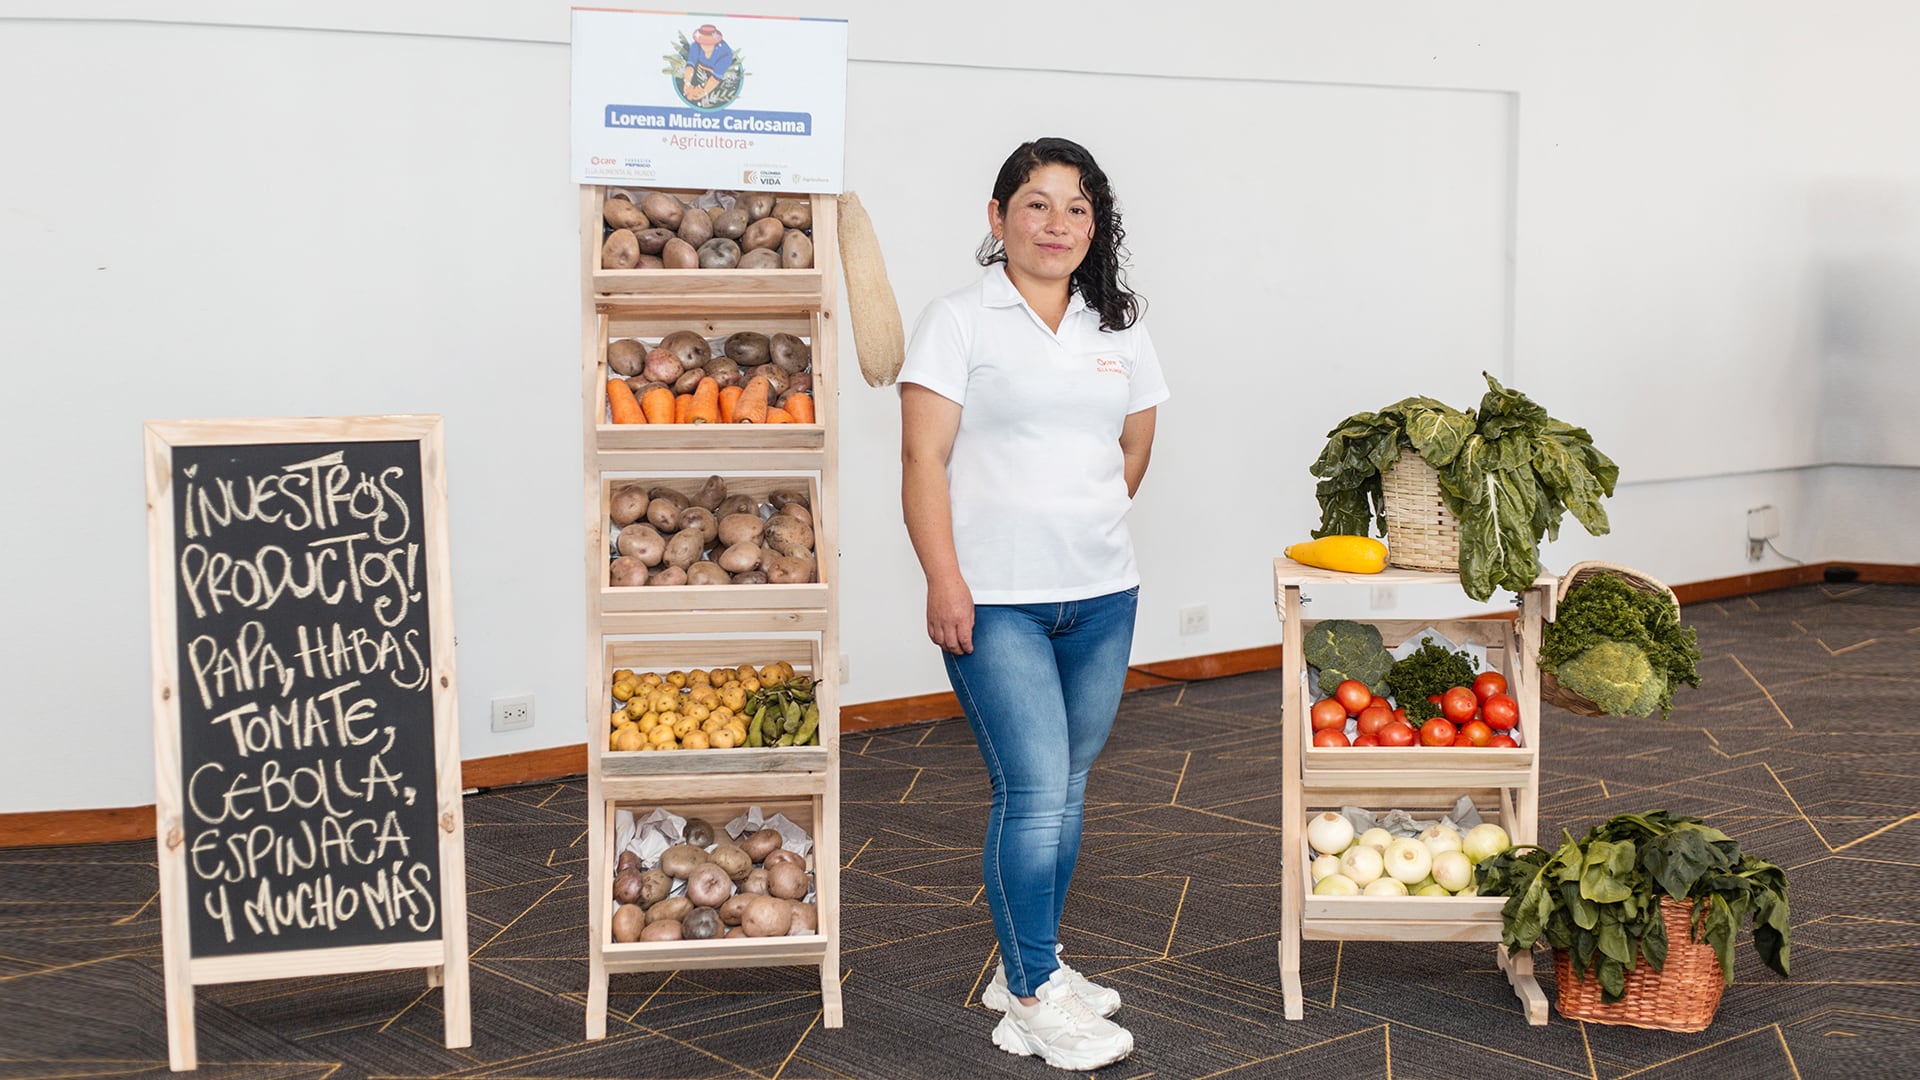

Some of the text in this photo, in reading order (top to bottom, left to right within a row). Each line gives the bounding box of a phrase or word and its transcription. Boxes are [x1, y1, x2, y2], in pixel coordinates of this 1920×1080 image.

[610, 110, 806, 134] Lorena Muñoz Carlosama
[669, 133, 748, 151] Agricultora
[760, 178, 781, 186] VIDA
[180, 532, 422, 628] PRODUCTOS!
[187, 620, 430, 710] PAPA, HABAS,
[210, 679, 397, 758] TOMATE,
[188, 753, 417, 825] CEBOLLA,
[190, 810, 411, 883] ESPINACA
[243, 873, 360, 936] MUCHO
[361, 860, 436, 934] MÁS
